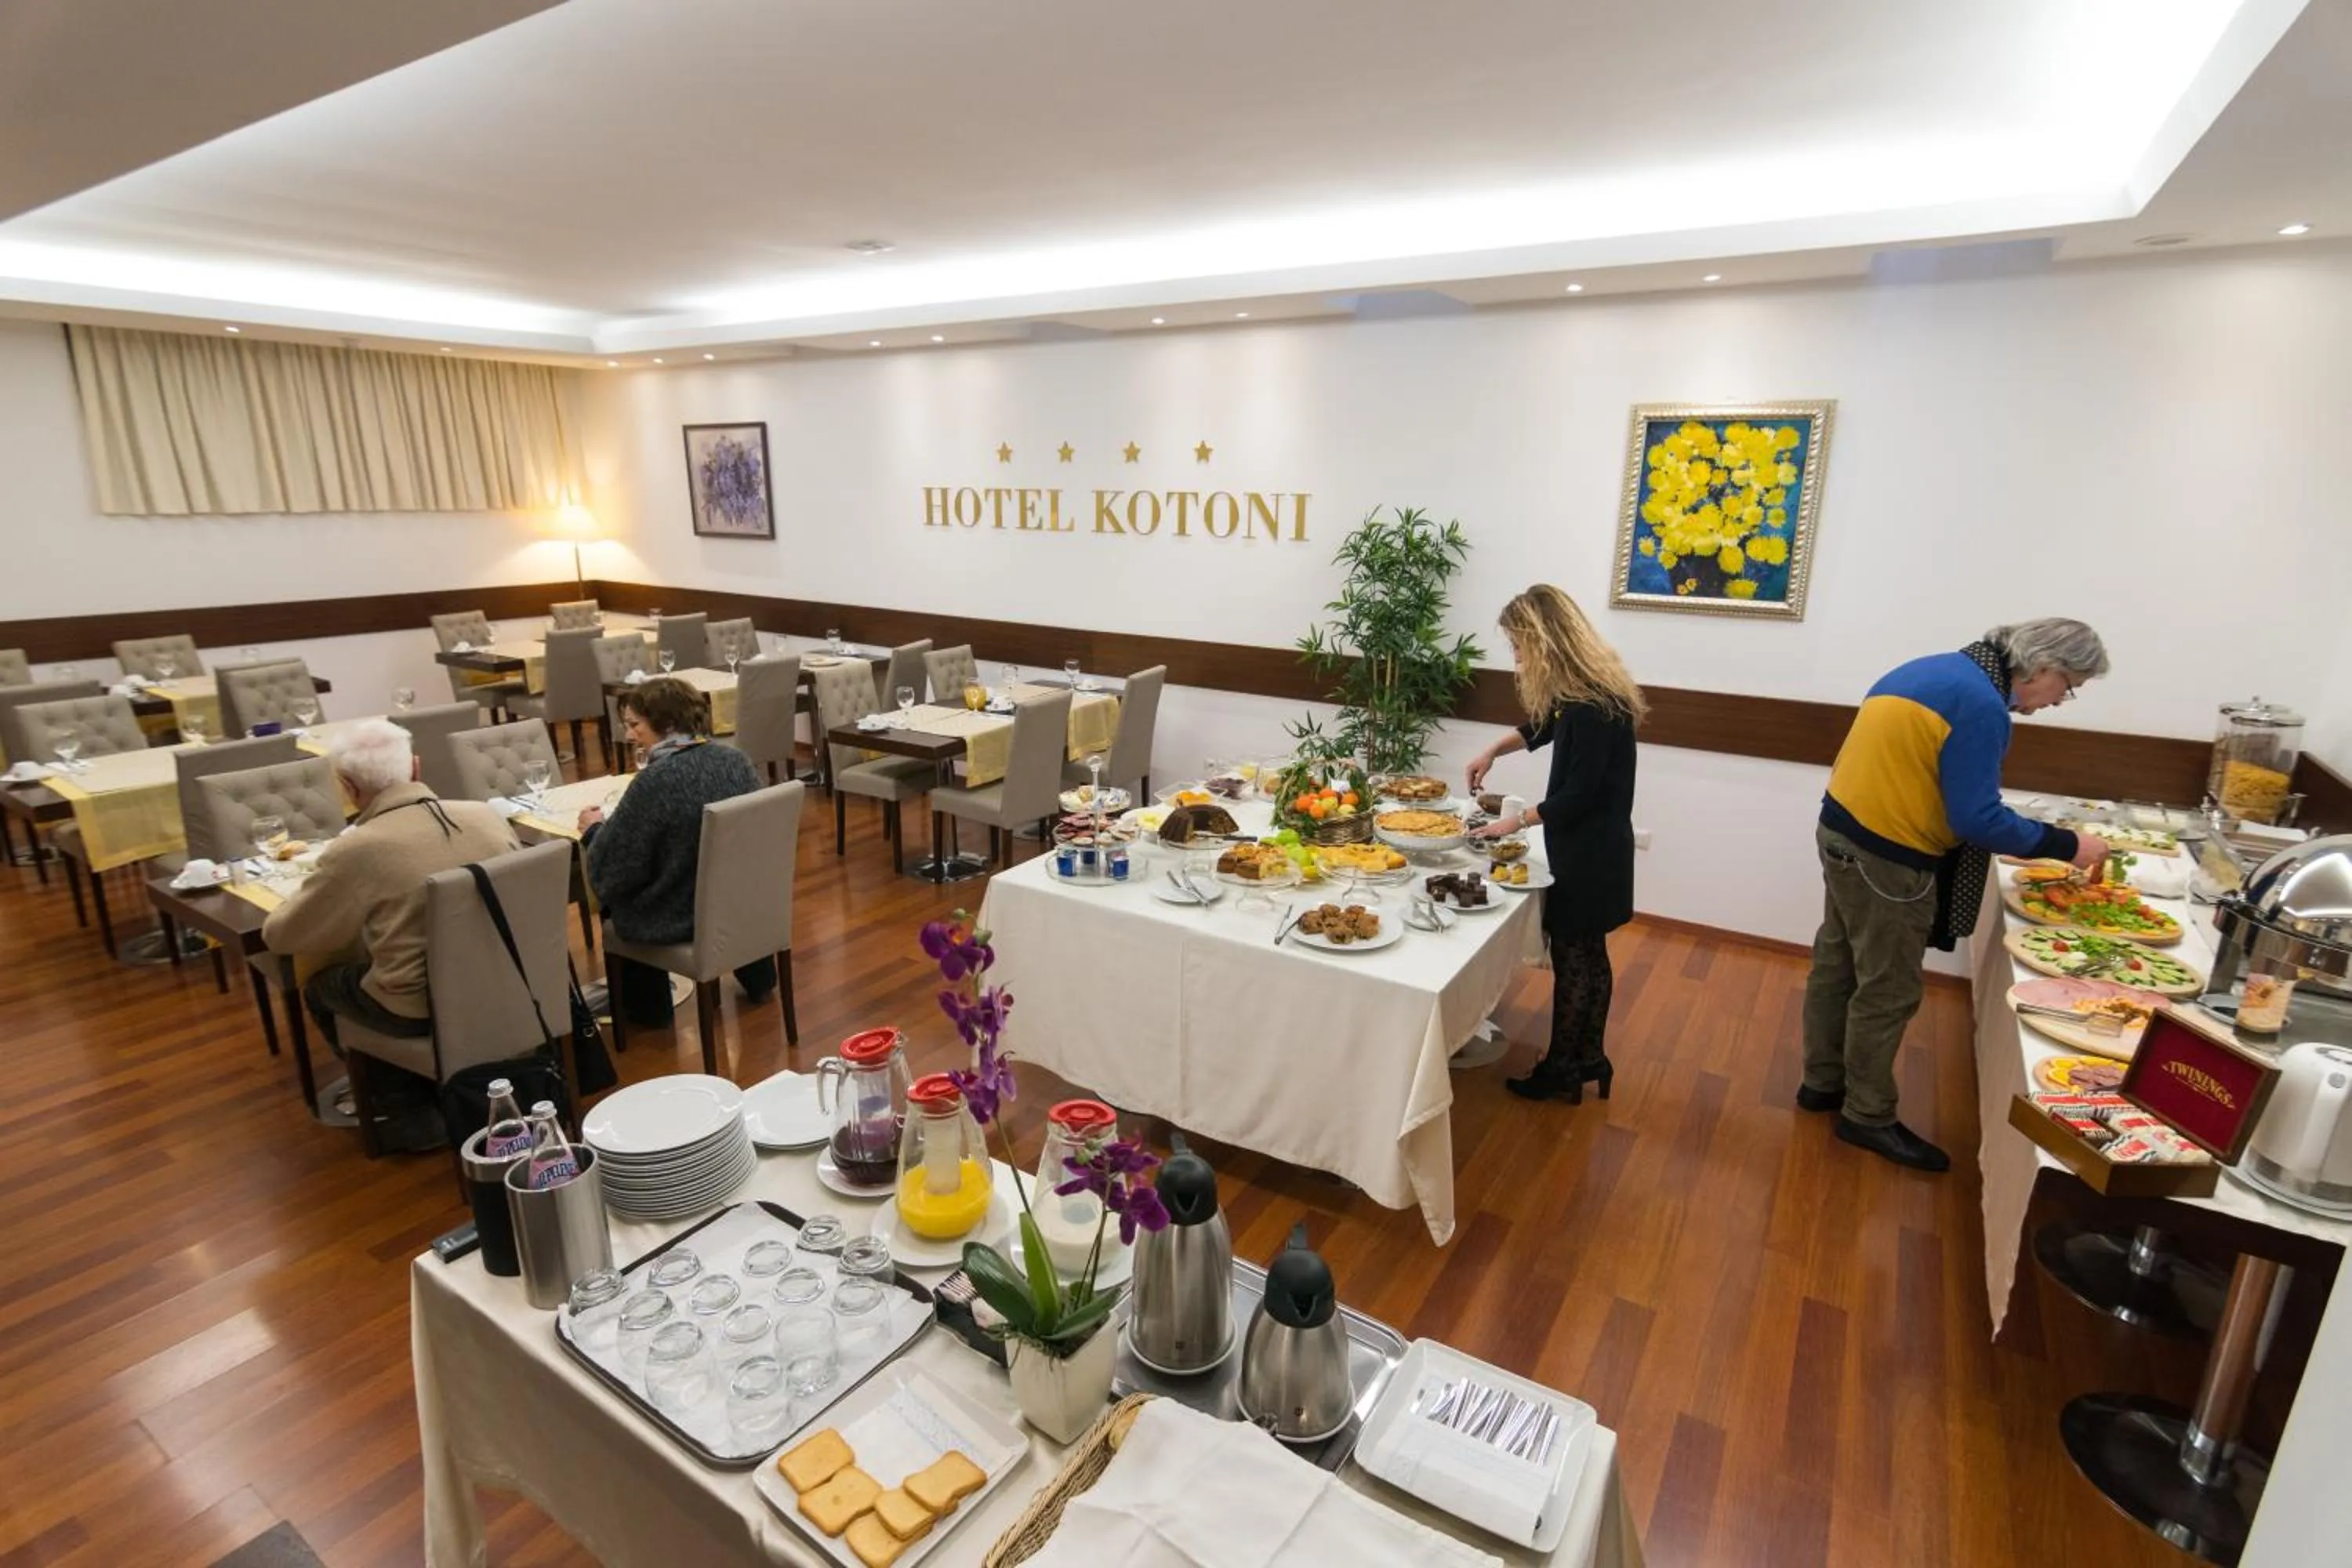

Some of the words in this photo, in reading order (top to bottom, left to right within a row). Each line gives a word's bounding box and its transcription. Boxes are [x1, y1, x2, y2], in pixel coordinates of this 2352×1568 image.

[923, 486, 1076, 532] HOTEL
[1091, 489, 1313, 544] KOTONI
[2169, 1060, 2233, 1105] TWININGS
